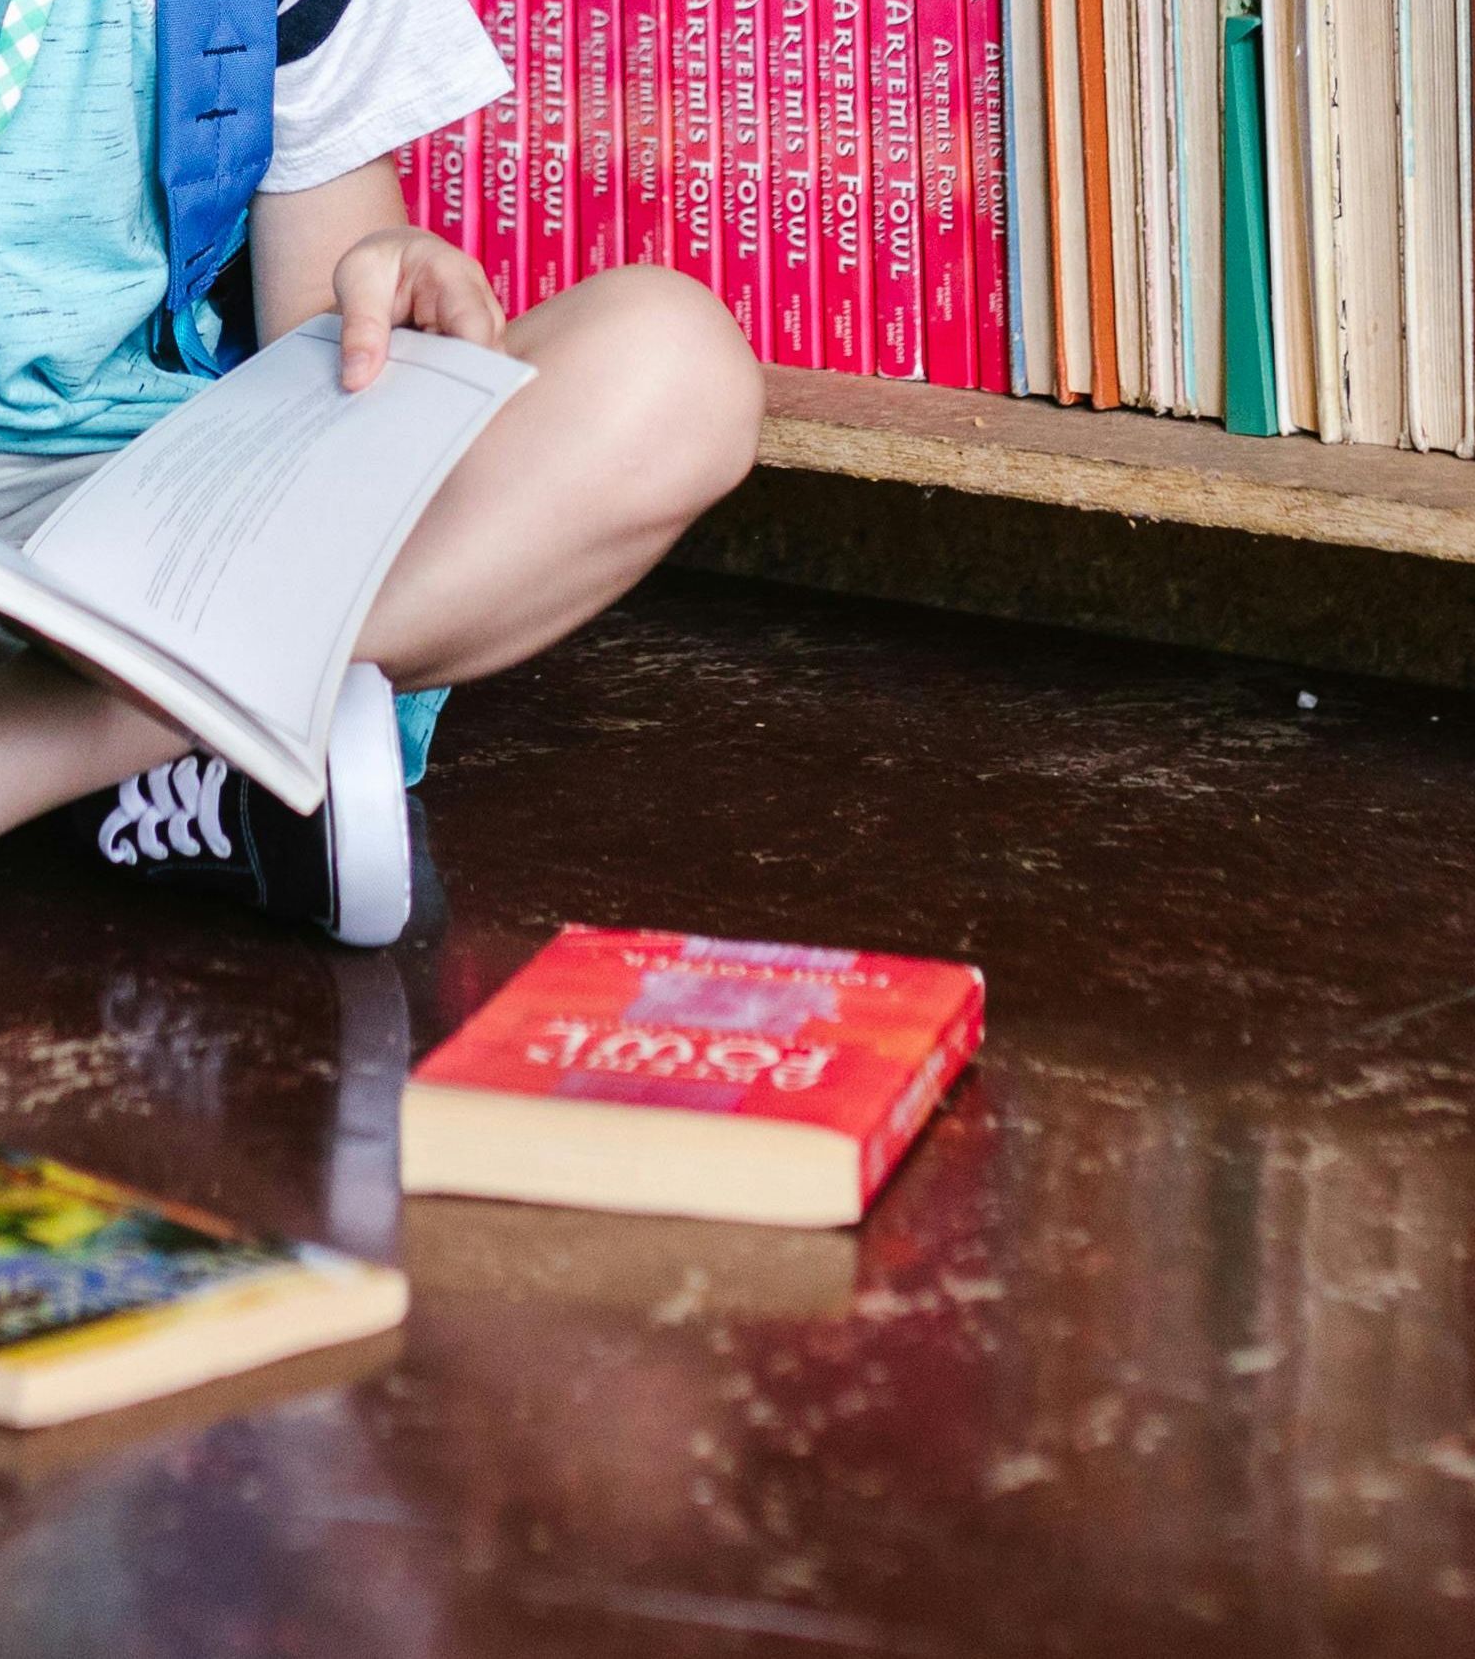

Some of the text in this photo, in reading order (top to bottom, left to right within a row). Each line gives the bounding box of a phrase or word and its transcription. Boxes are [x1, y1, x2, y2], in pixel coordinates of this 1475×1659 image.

[785, 169, 811, 270] FOWL
[837, 173, 863, 274] FOWL
[889, 179, 916, 281] FOWL
[937, 164, 957, 235] FOWL
